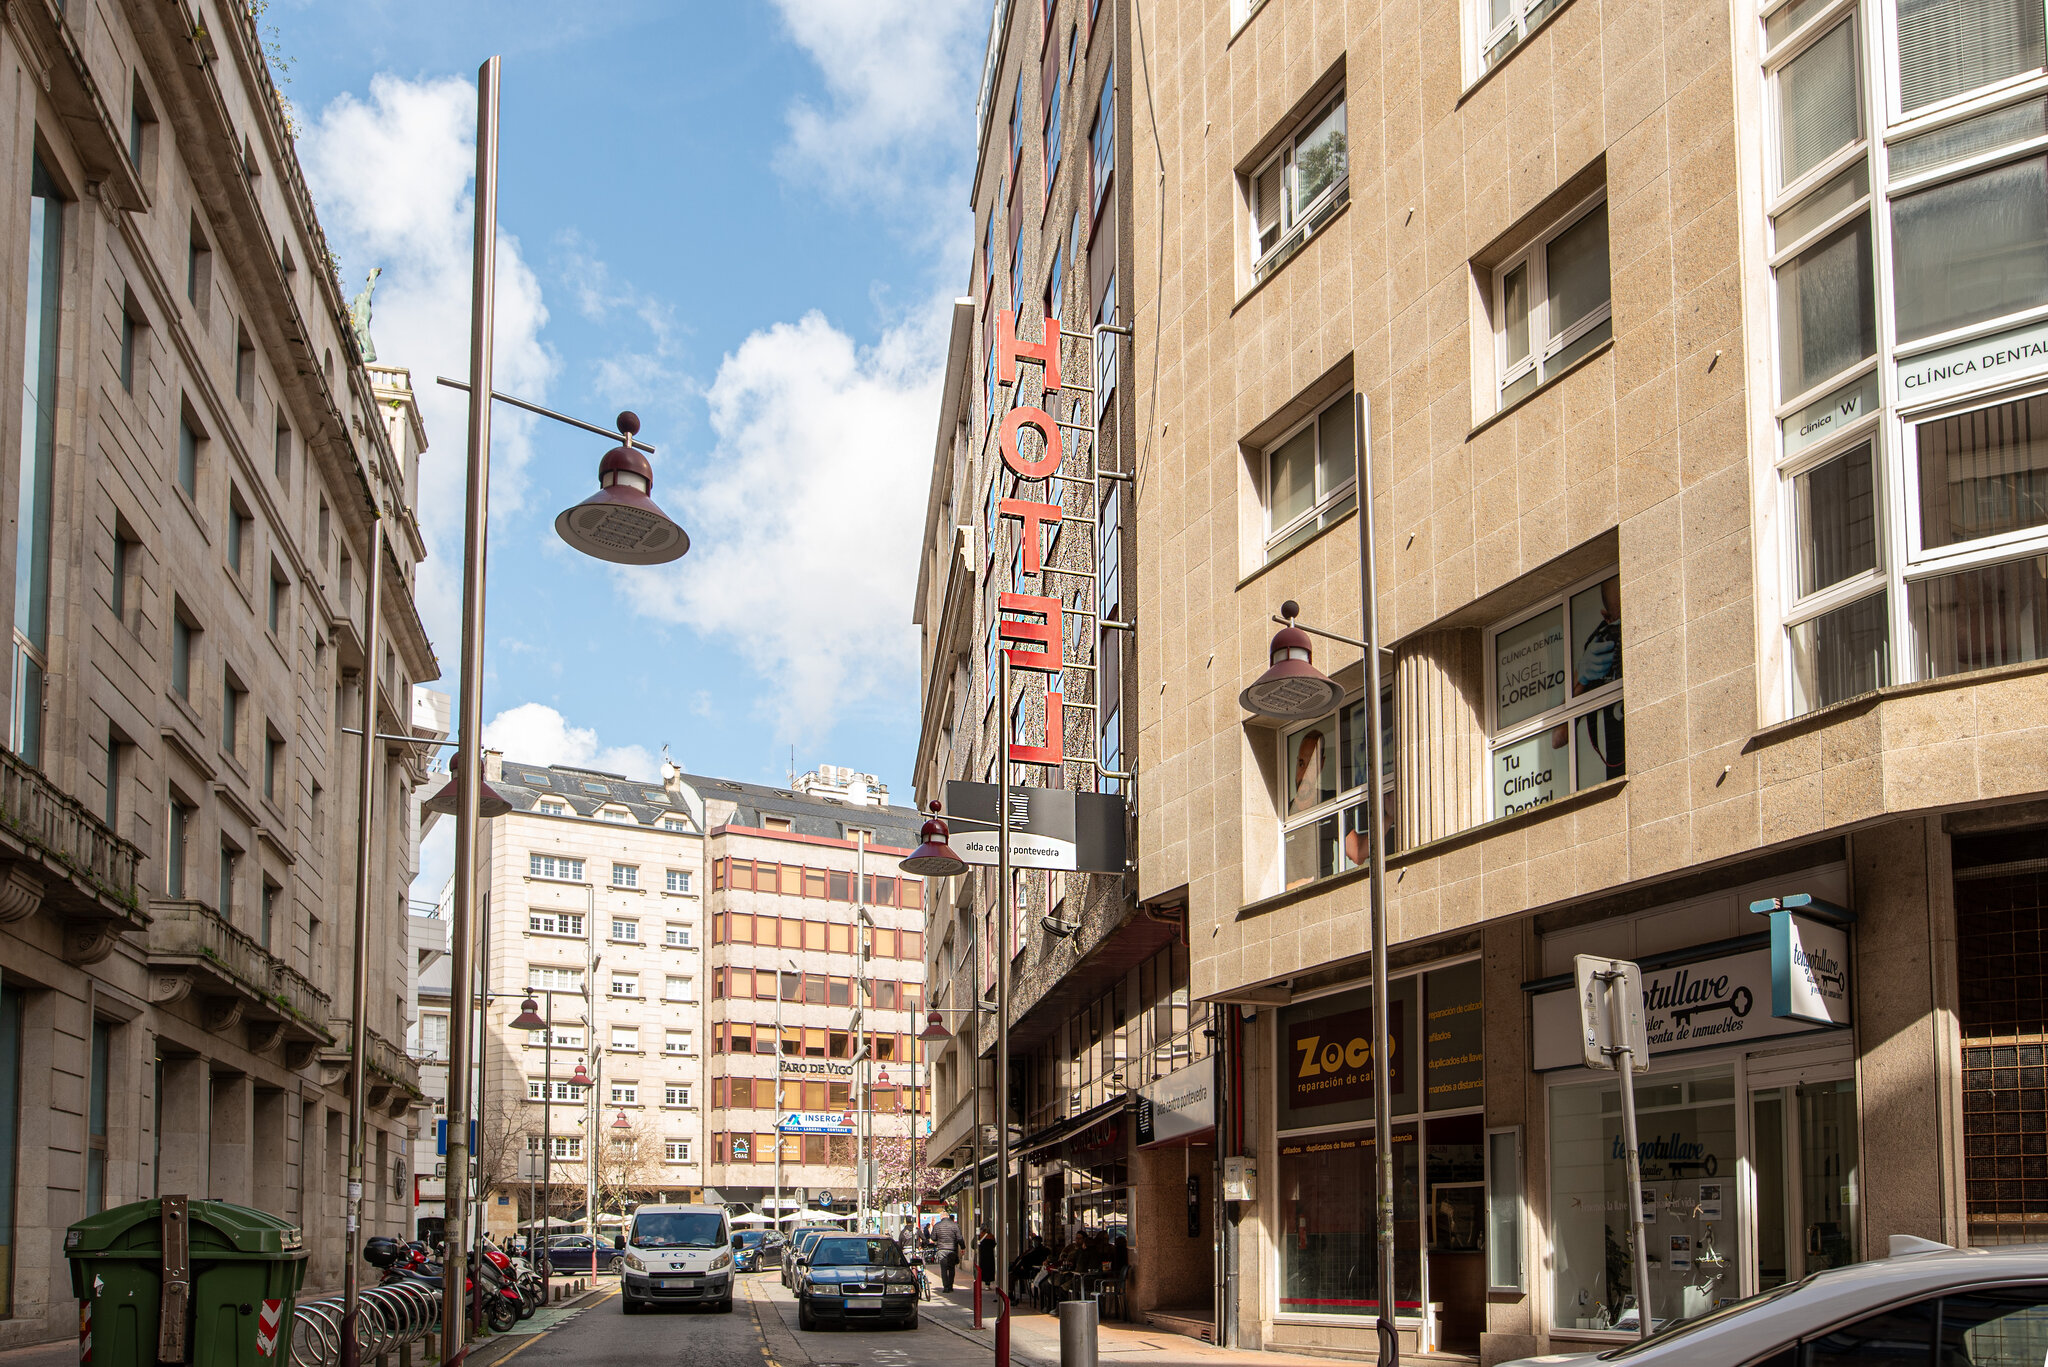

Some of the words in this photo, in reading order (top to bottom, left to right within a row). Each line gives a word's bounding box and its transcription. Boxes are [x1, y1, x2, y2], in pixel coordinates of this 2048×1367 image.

[1904, 367, 1977, 389] CLÍNICA
[1982, 340, 2048, 369] DENTAL
[1840, 397, 1857, 416] W
[1533, 631, 1564, 652] DENTAL
[1502, 669, 1565, 708] LORENZO
[1502, 754, 1521, 772] Tu
[1503, 768, 1553, 796] Clínica
[966, 842, 983, 852] alda
[1013, 845, 1060, 857] pontevedra
[1456, 1004, 1464, 1014] de
[1463, 1000, 1483, 1012] calzad
[1428, 1030, 1452, 1043] afilados
[1647, 1030, 1674, 1045] venta
[1676, 1025, 1690, 1041] de
[1692, 1016, 1744, 1038] inmuebles
[779, 1060, 807, 1073] FARO
[809, 1063, 825, 1073] DE
[825, 1062, 854, 1076] VIGO
[1428, 1055, 1461, 1070] duplicados
[1461, 1054, 1468, 1064] de
[1468, 1052, 1484, 1063] llave
[1297, 1077, 1343, 1094] reparación
[1346, 1074, 1357, 1085] de
[1360, 1068, 1396, 1082] calo
[1428, 1082, 1452, 1095] mandos
[1457, 1078, 1484, 1091] distancia
[1157, 1099, 1166, 1116] alda
[1180, 1083, 1207, 1111] pontevedra
[1282, 1146, 1302, 1155] afilados
[1306, 1143, 1333, 1153] duplicados
[1333, 1142, 1340, 1150] de
[1340, 1140, 1356, 1149] llaves
[1612, 1132, 1705, 1165] tegotullave
